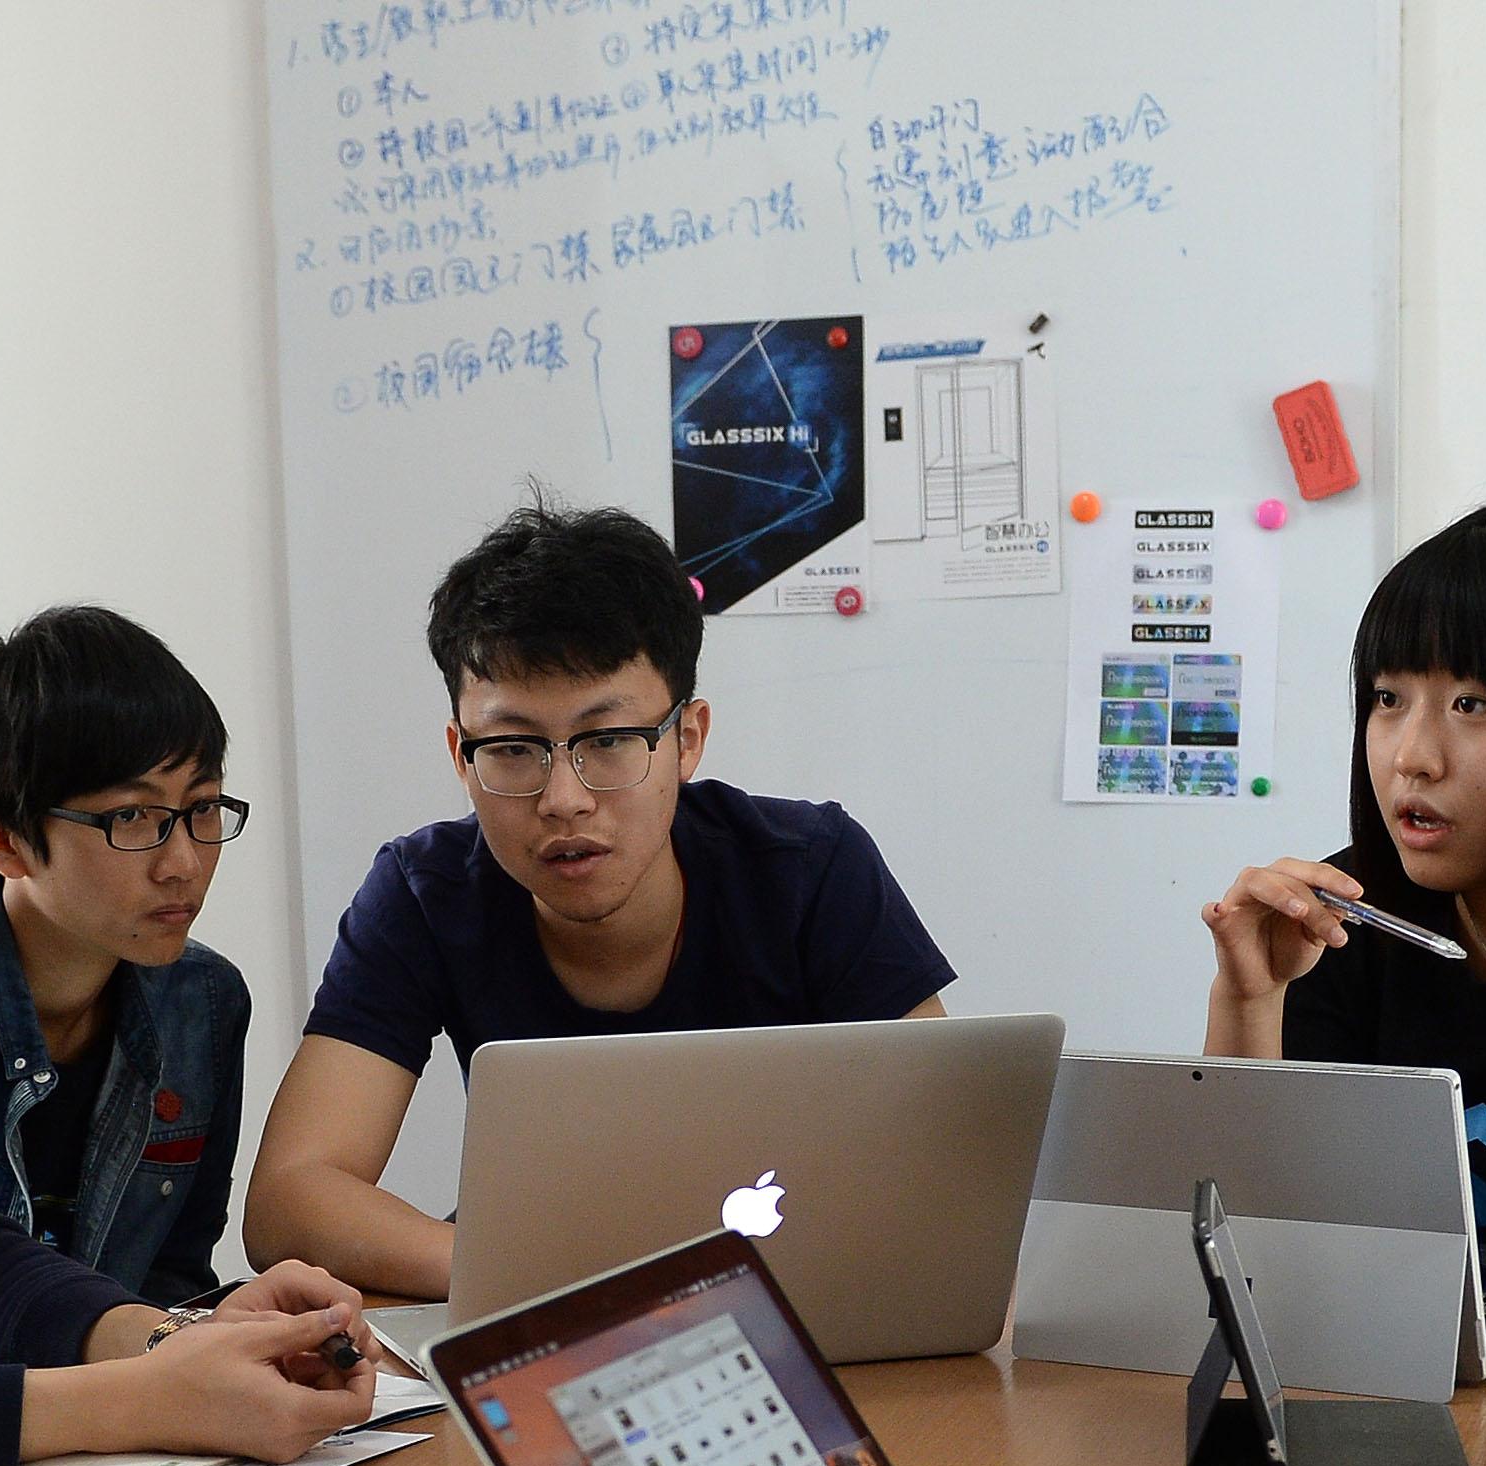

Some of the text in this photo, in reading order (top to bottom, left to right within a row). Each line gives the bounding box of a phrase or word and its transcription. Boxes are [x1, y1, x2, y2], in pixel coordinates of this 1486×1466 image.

[686, 426, 785, 446] GLASSSIX
[1136, 513, 1213, 527] GLASSSIX
[985, 521, 1050, 541] 智慧办公
[1136, 541, 1211, 552] GLASSSIX
[1135, 567, 1211, 580] GLASSSIX
[1133, 626, 1209, 640] GLASSSIX
